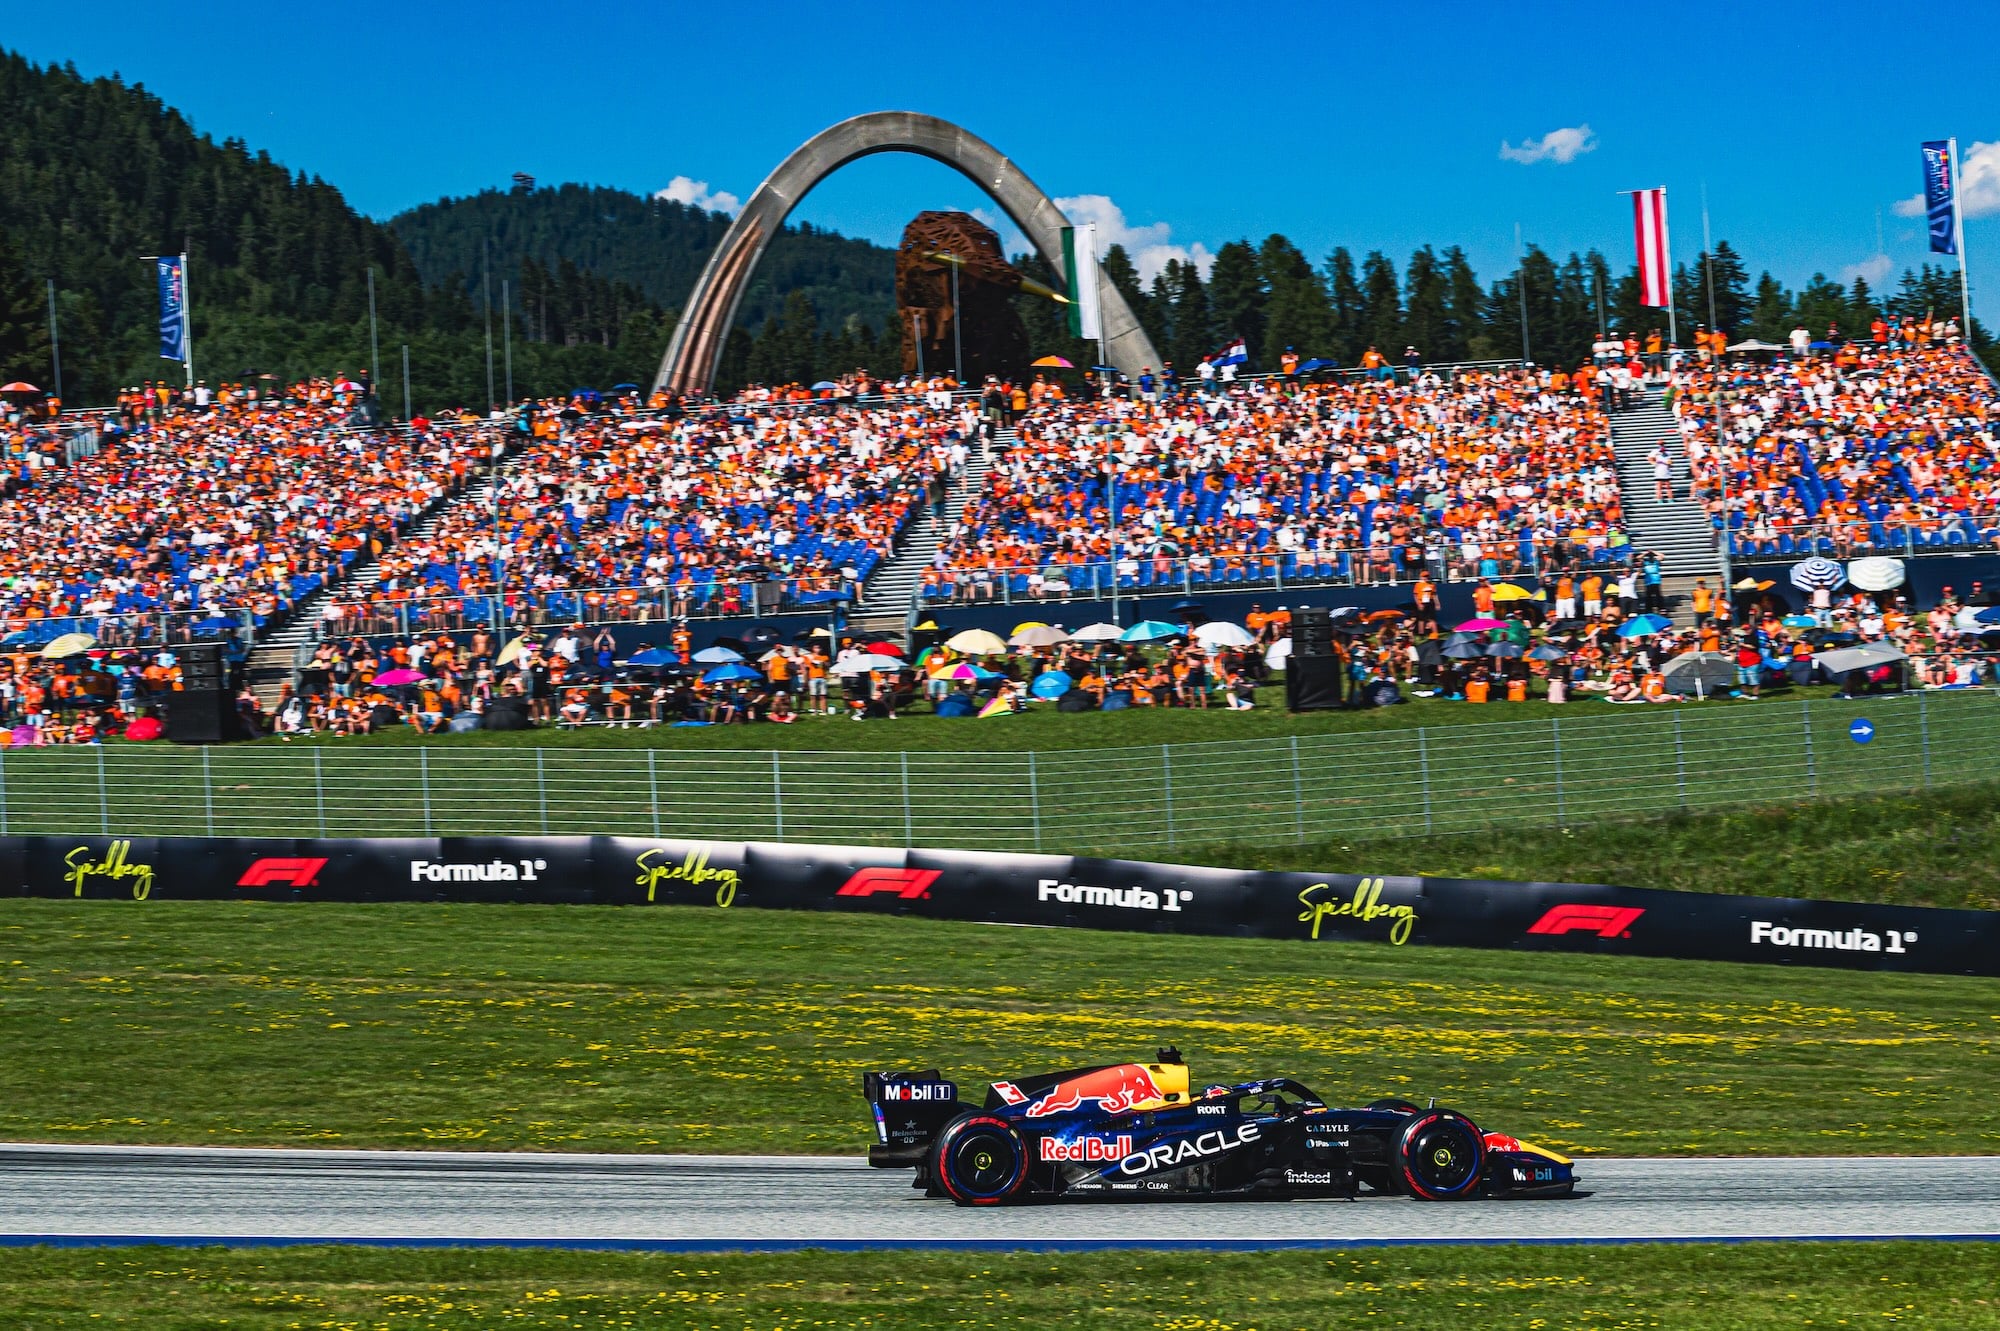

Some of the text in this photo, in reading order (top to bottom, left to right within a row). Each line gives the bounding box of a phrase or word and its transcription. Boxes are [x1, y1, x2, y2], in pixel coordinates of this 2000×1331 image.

[64, 840, 155, 901] Spielberg
[410, 860, 519, 881] Formula
[635, 848, 741, 908] Spielberg
[1038, 879, 1159, 910] Formula
[1298, 878, 1418, 945] Spielberg
[1750, 921, 1881, 952] Formula
[885, 1085, 932, 1100] Mobil
[1197, 1105, 1227, 1115] ROKT
[1306, 1124, 1350, 1133] CARLYLE
[1041, 1135, 1132, 1161] Red Bull
[1120, 1123, 1261, 1176] ORACLE
[1286, 1169, 1331, 1184] indeed
[1512, 1168, 1552, 1181] Mobil
